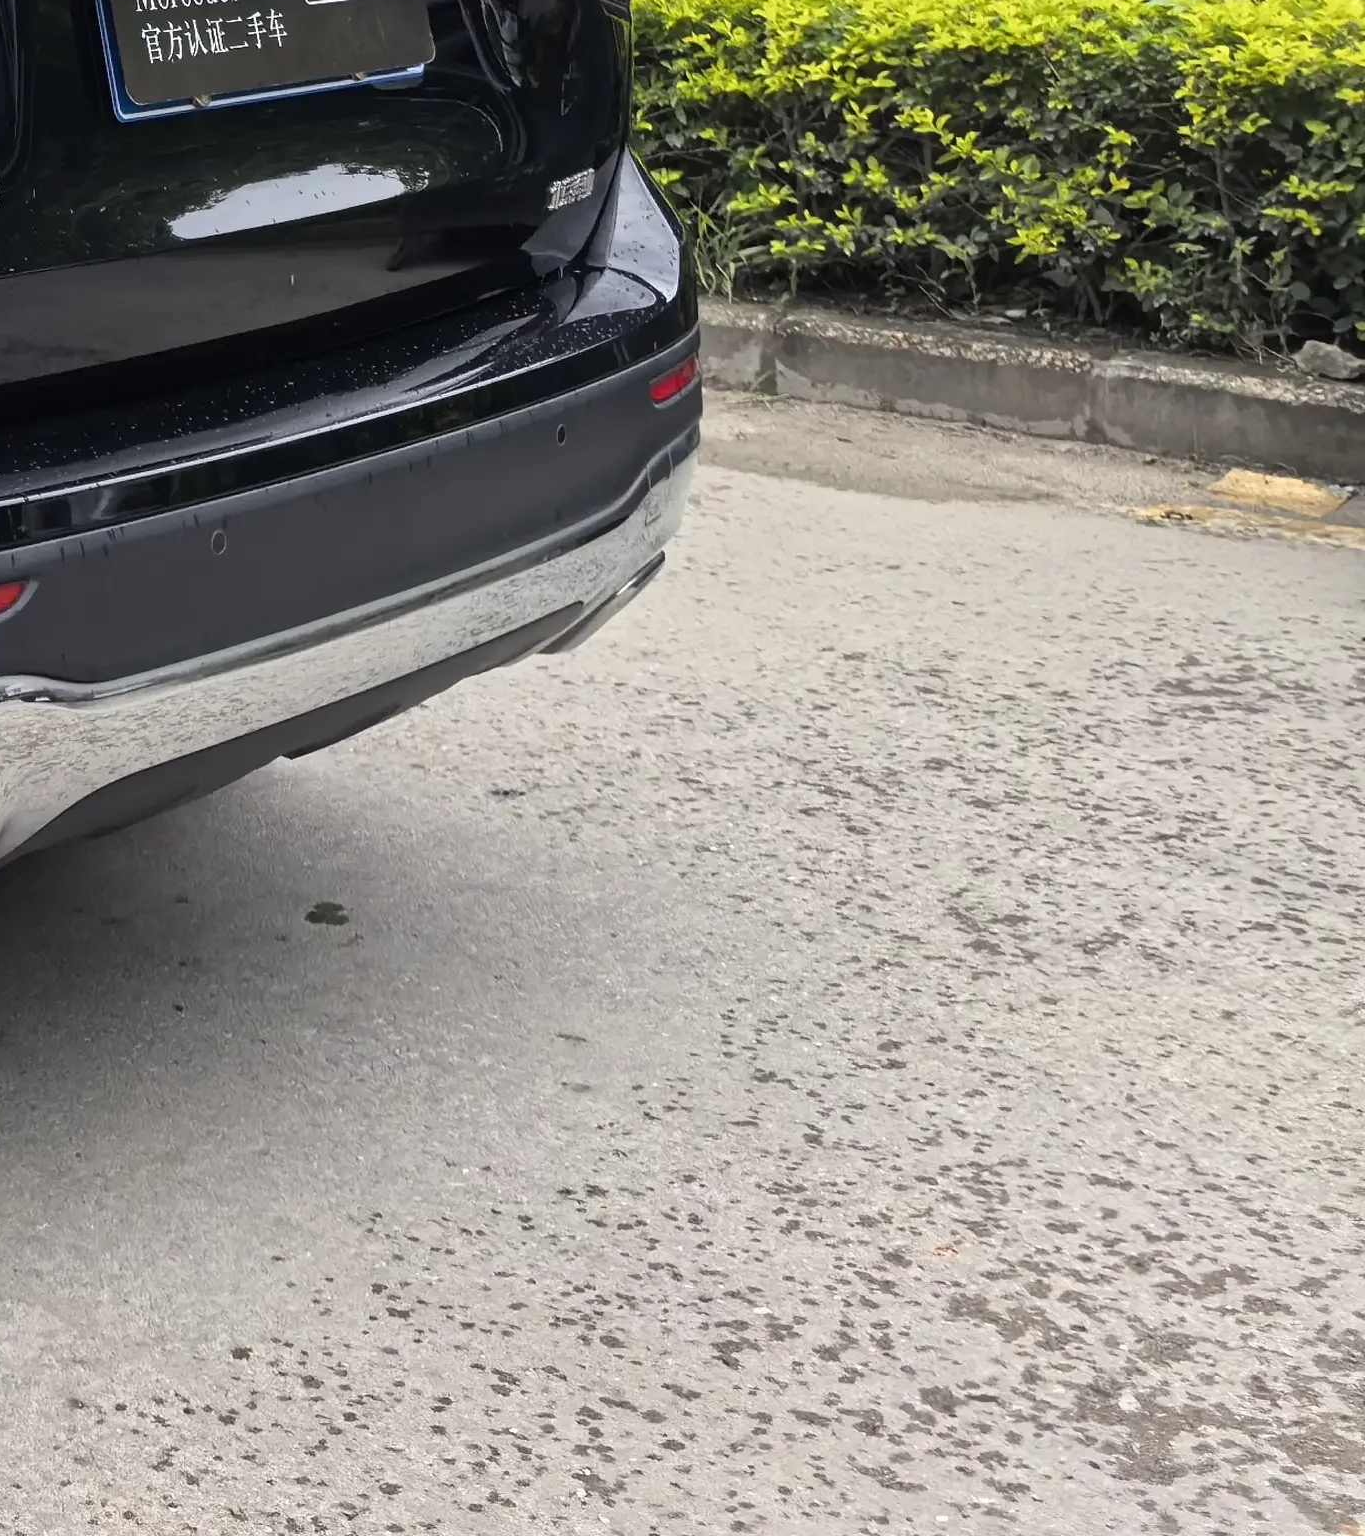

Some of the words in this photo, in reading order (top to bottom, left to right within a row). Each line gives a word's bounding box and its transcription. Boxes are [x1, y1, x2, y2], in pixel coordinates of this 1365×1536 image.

[141, 8, 288, 64] 官方认证二手车
